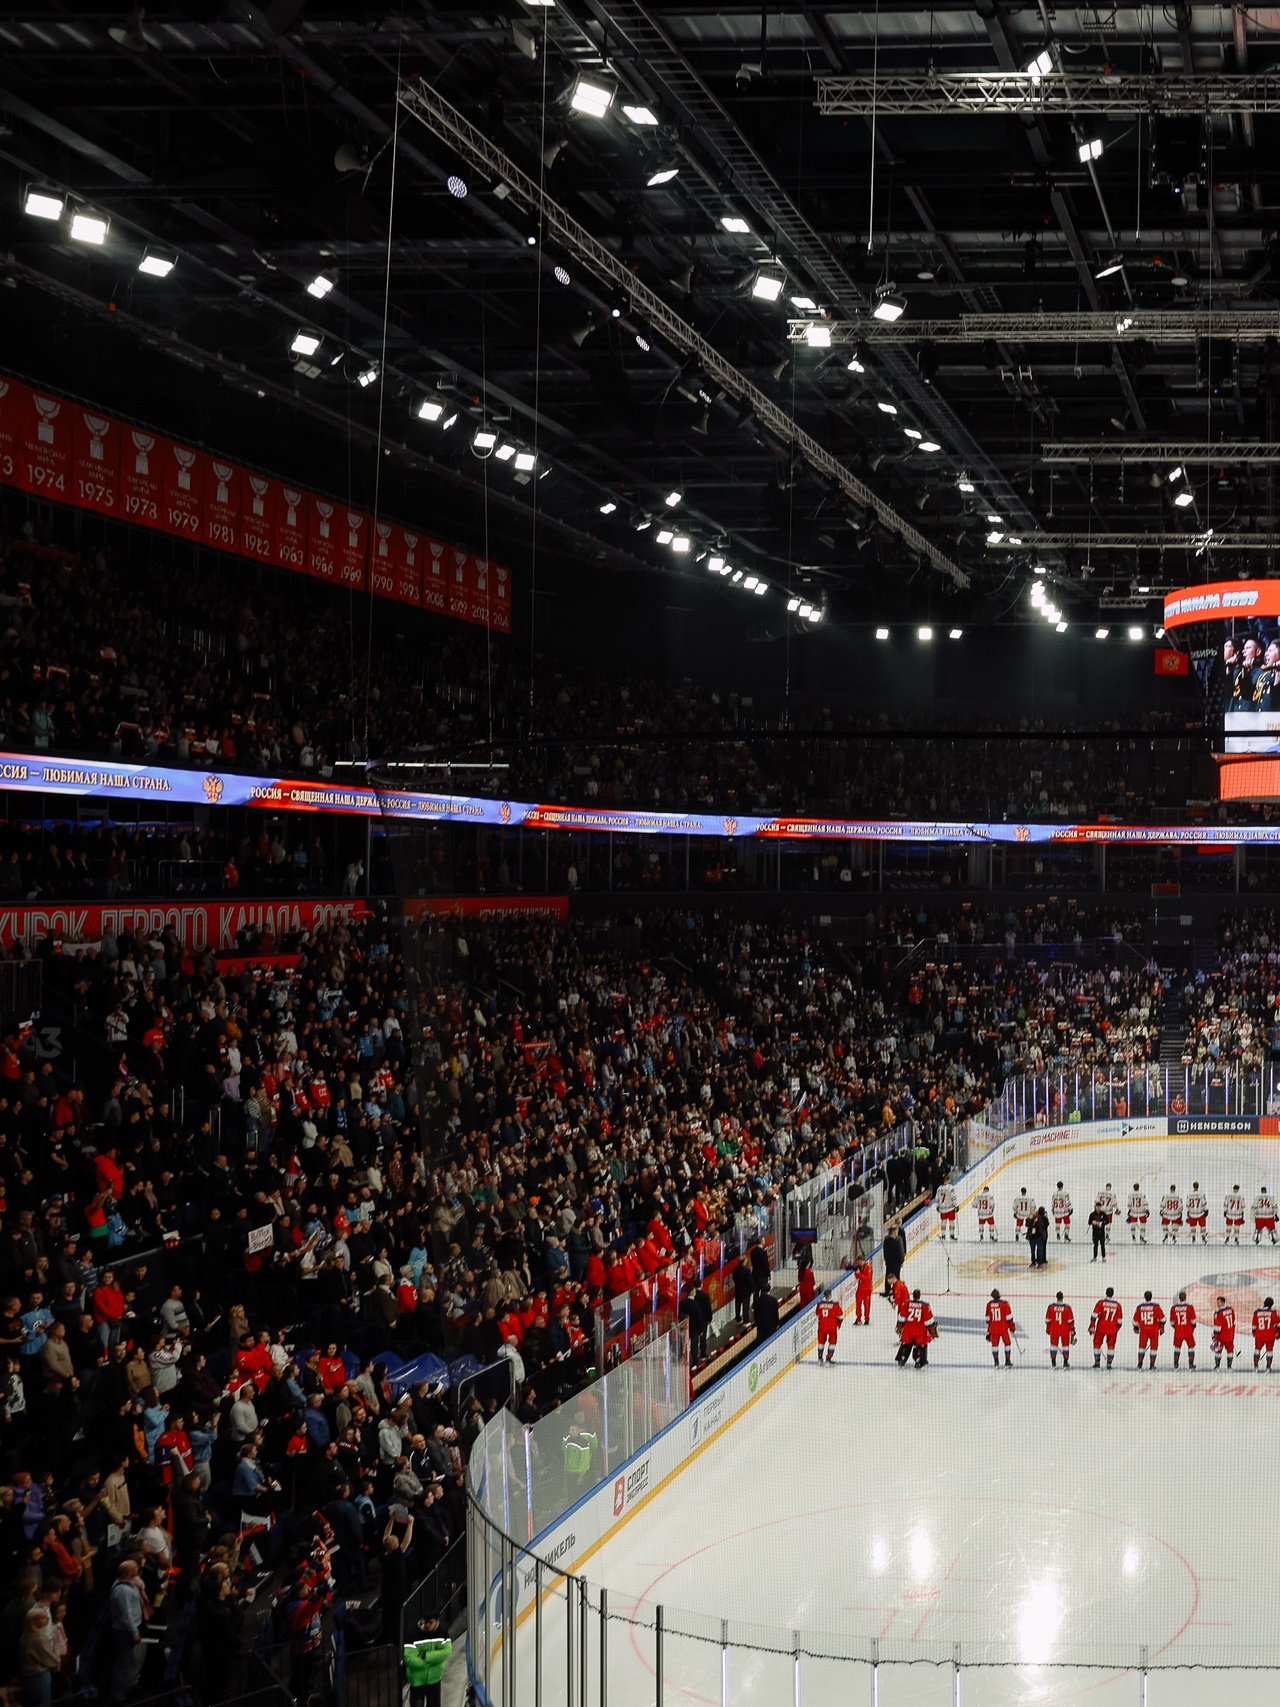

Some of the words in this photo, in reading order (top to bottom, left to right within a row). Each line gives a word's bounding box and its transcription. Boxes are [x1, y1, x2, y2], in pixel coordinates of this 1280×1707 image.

[27, 463, 66, 493] 1974
[79, 479, 114, 507] 1975
[125, 494, 158, 519] 1978
[168, 507, 199, 532] 1979
[209, 522, 234, 545] 1981
[244, 533, 270, 556] 1982
[279, 543, 304, 566] 1983
[371, 572, 393, 593] 1990
[400, 581, 421, 601] 1993
[42, 767, 98, 785] ЛЮБИМАЯ
[100, 773, 131, 790] НАША
[132, 776, 172, 791] СТРАНА.
[250, 786, 282, 800] РОССИЯ
[291, 790, 334, 804] СВЯЩЕННАЯ
[335, 793, 355, 806] НАША
[387, 798, 411, 809] РОССИЯ
[756, 823, 780, 832] РОССИЯ
[787, 824, 827, 834] СВЯЩЕННАЯ
[827, 825, 845, 834] НАША
[846, 825, 876, 835] ДЕРЖАВА,
[877, 826, 903, 834] РОССИЯ
[1051, 829, 1078, 838] РОССИЯ
[1180, 831, 1207, 840] РОССИЯ
[1190, 1122, 1251, 1131] HENDERSON
[1030, 1135, 1041, 1147] RED
[1041, 1130, 1071, 1144] MACHINE
[940, 1193, 946, 1204] 7
[1020, 1201, 1028, 1211] 11
[907, 1308, 922, 1322] 29
[990, 1308, 1001, 1321] 10
[1055, 1311, 1062, 1325] 4
[1104, 1307, 1117, 1321] 77
[1140, 1311, 1154, 1325] 45
[1176, 1312, 1187, 1326] 13
[1225, 1313, 1233, 1329] 11
[1258, 1317, 1271, 1330] 87
[627, 1459, 650, 1491] СПОРТ
